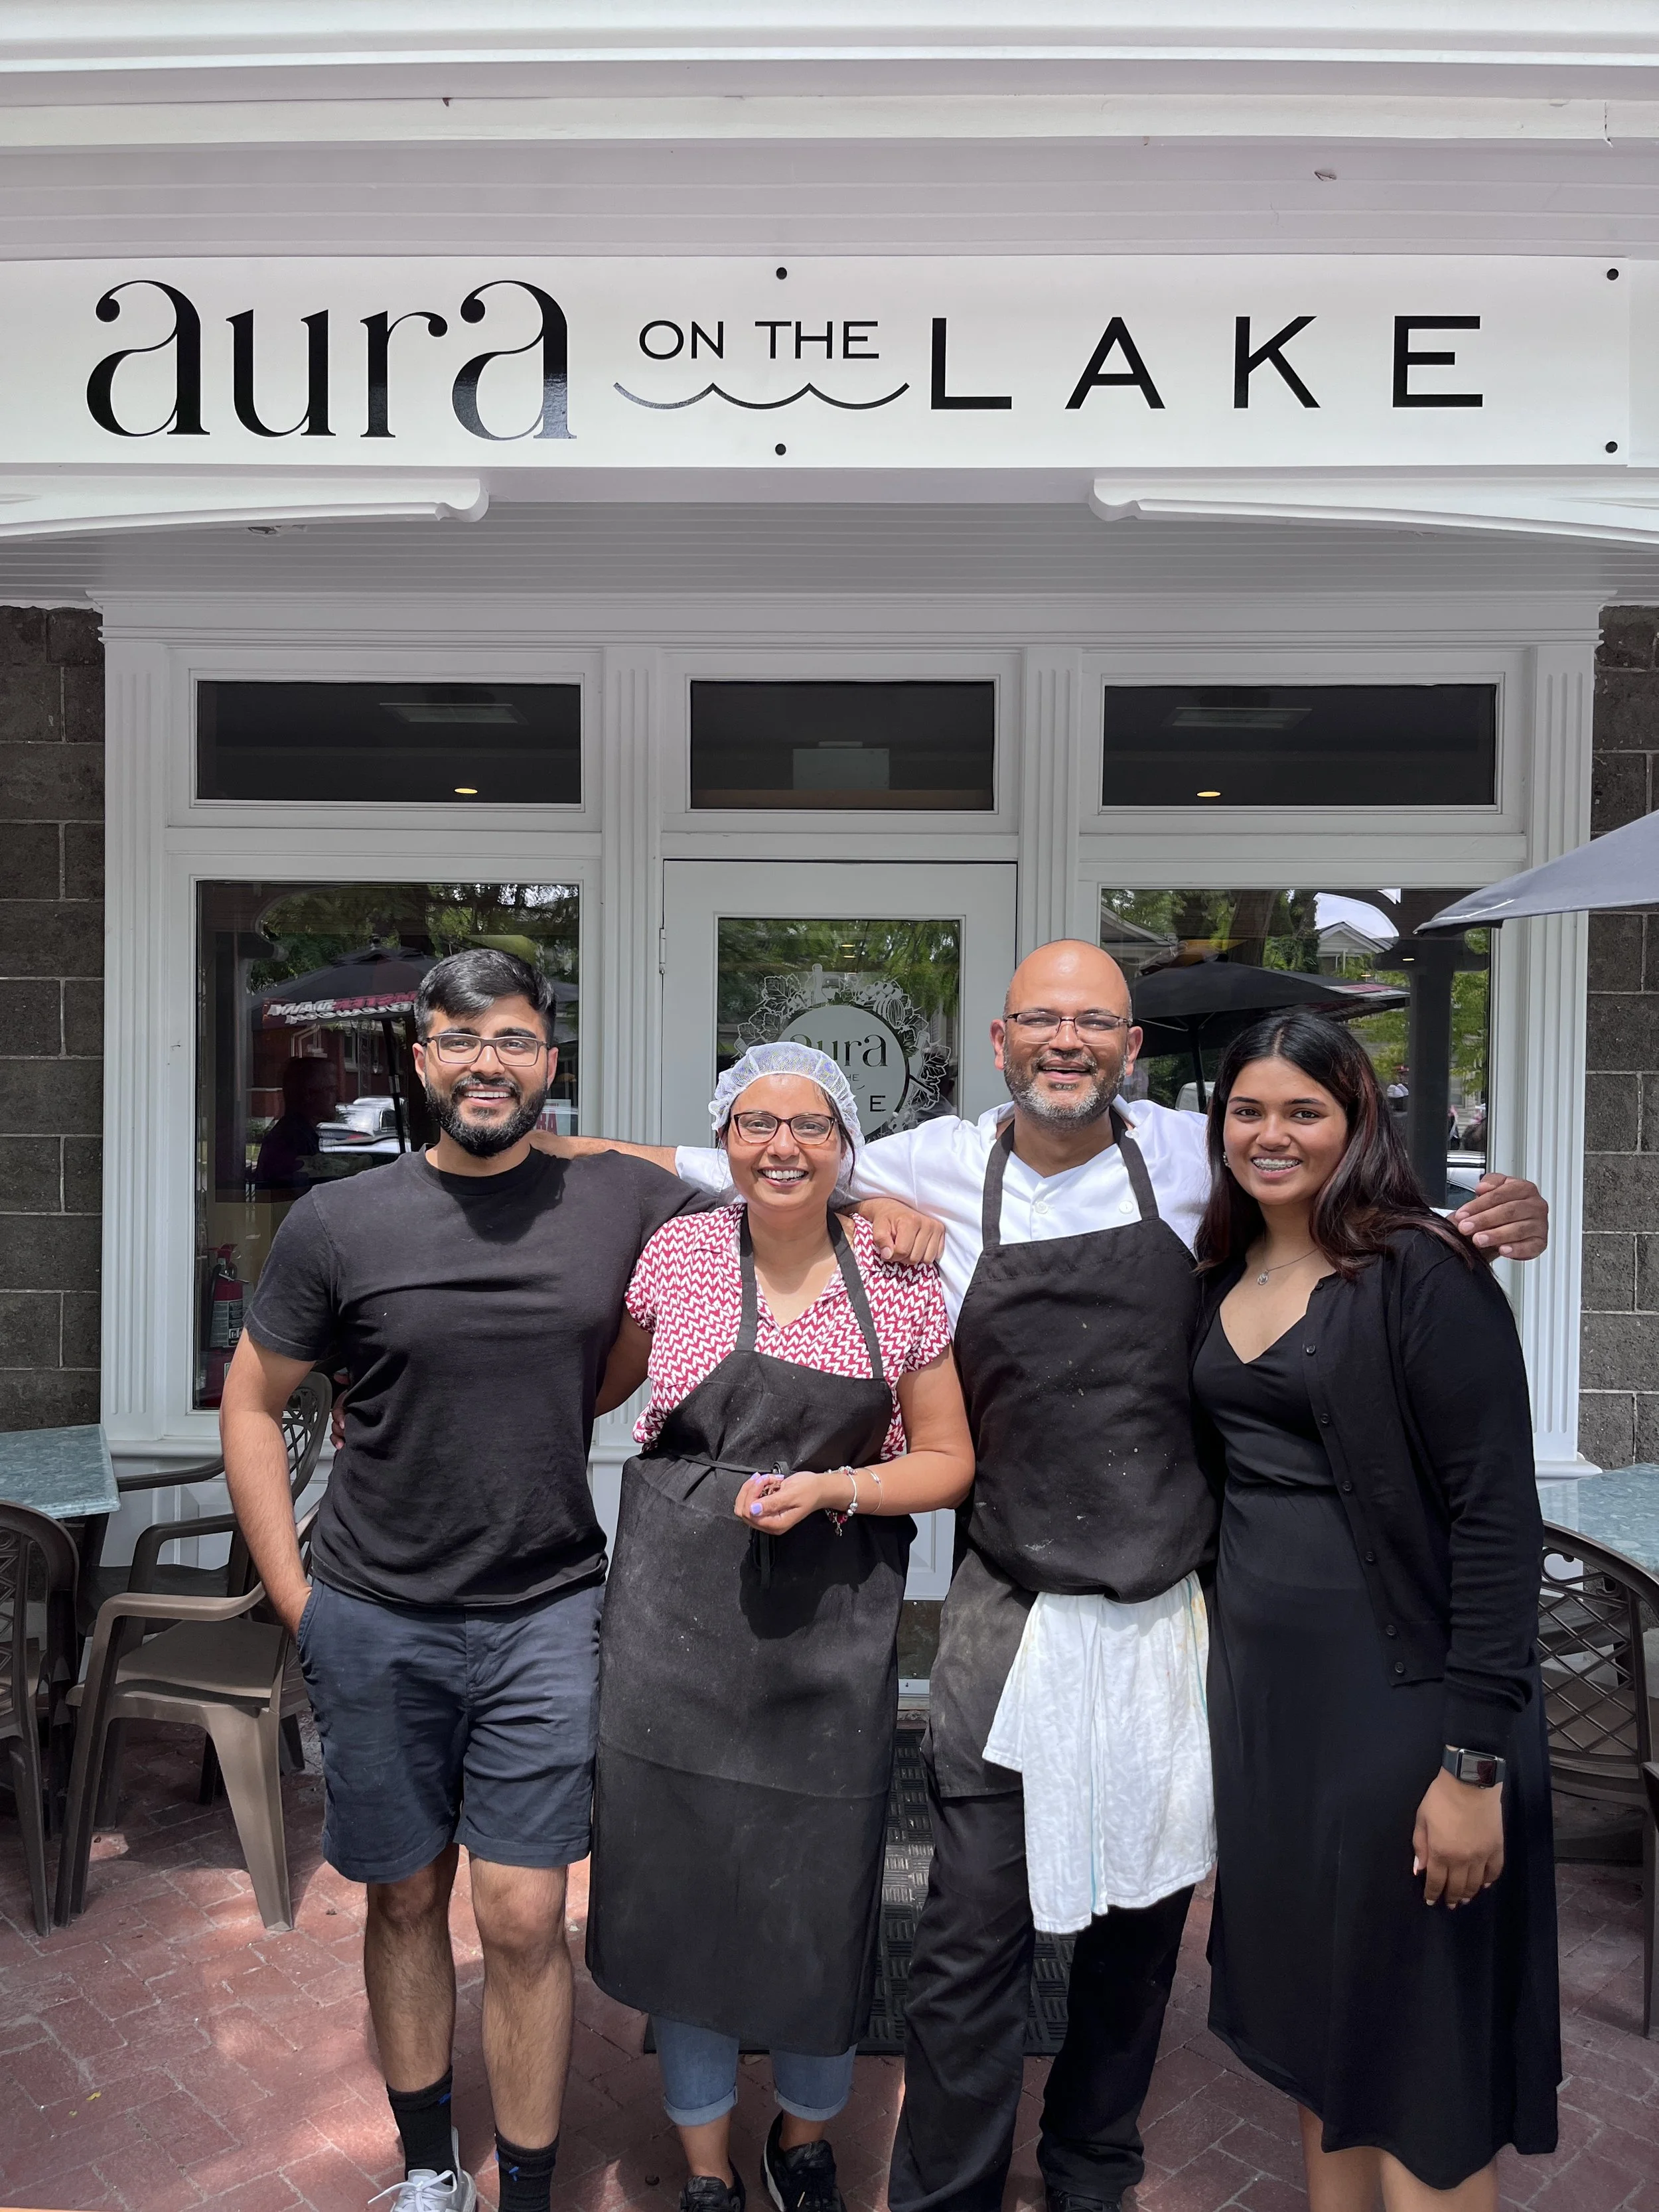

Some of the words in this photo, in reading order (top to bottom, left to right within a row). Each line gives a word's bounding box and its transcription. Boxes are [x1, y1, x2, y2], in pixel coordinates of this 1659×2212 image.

[86, 279, 577, 441] aura
[639, 320, 724, 360] ON
[755, 321, 879, 359] THE
[931, 315, 1483, 410] LAKE
